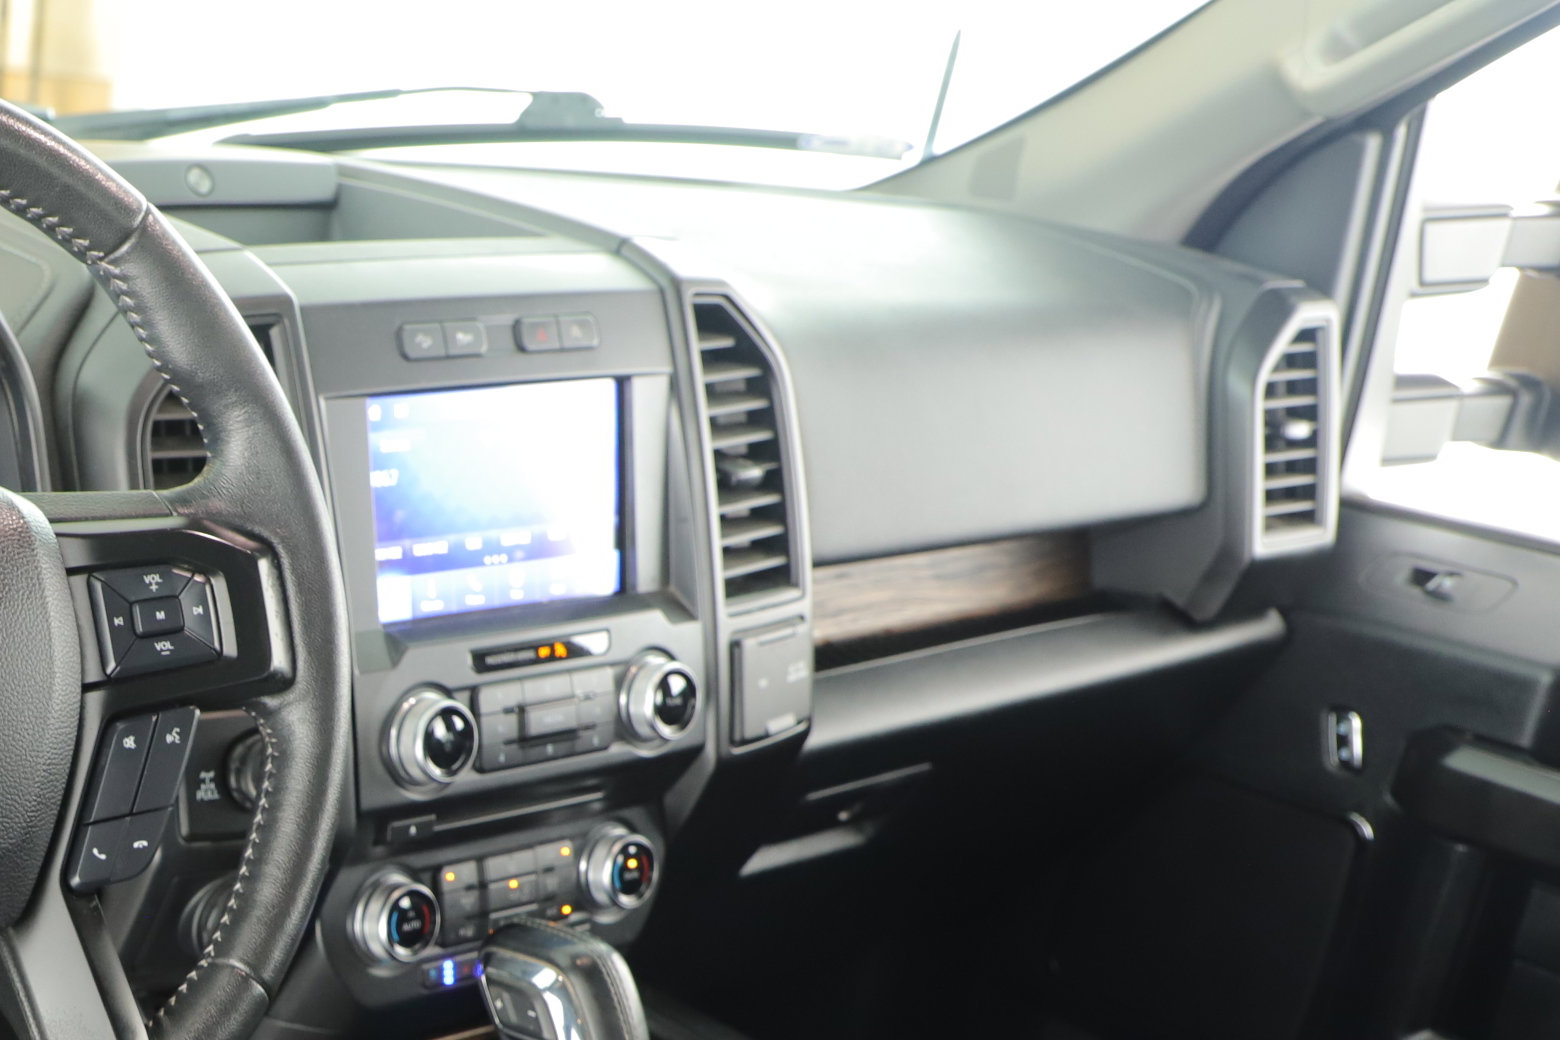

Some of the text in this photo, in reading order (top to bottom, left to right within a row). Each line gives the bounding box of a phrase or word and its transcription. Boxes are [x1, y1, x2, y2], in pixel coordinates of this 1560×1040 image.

[143, 573, 163, 584] VOL
[155, 610, 166, 620] M
[154, 640, 175, 652] VOL
